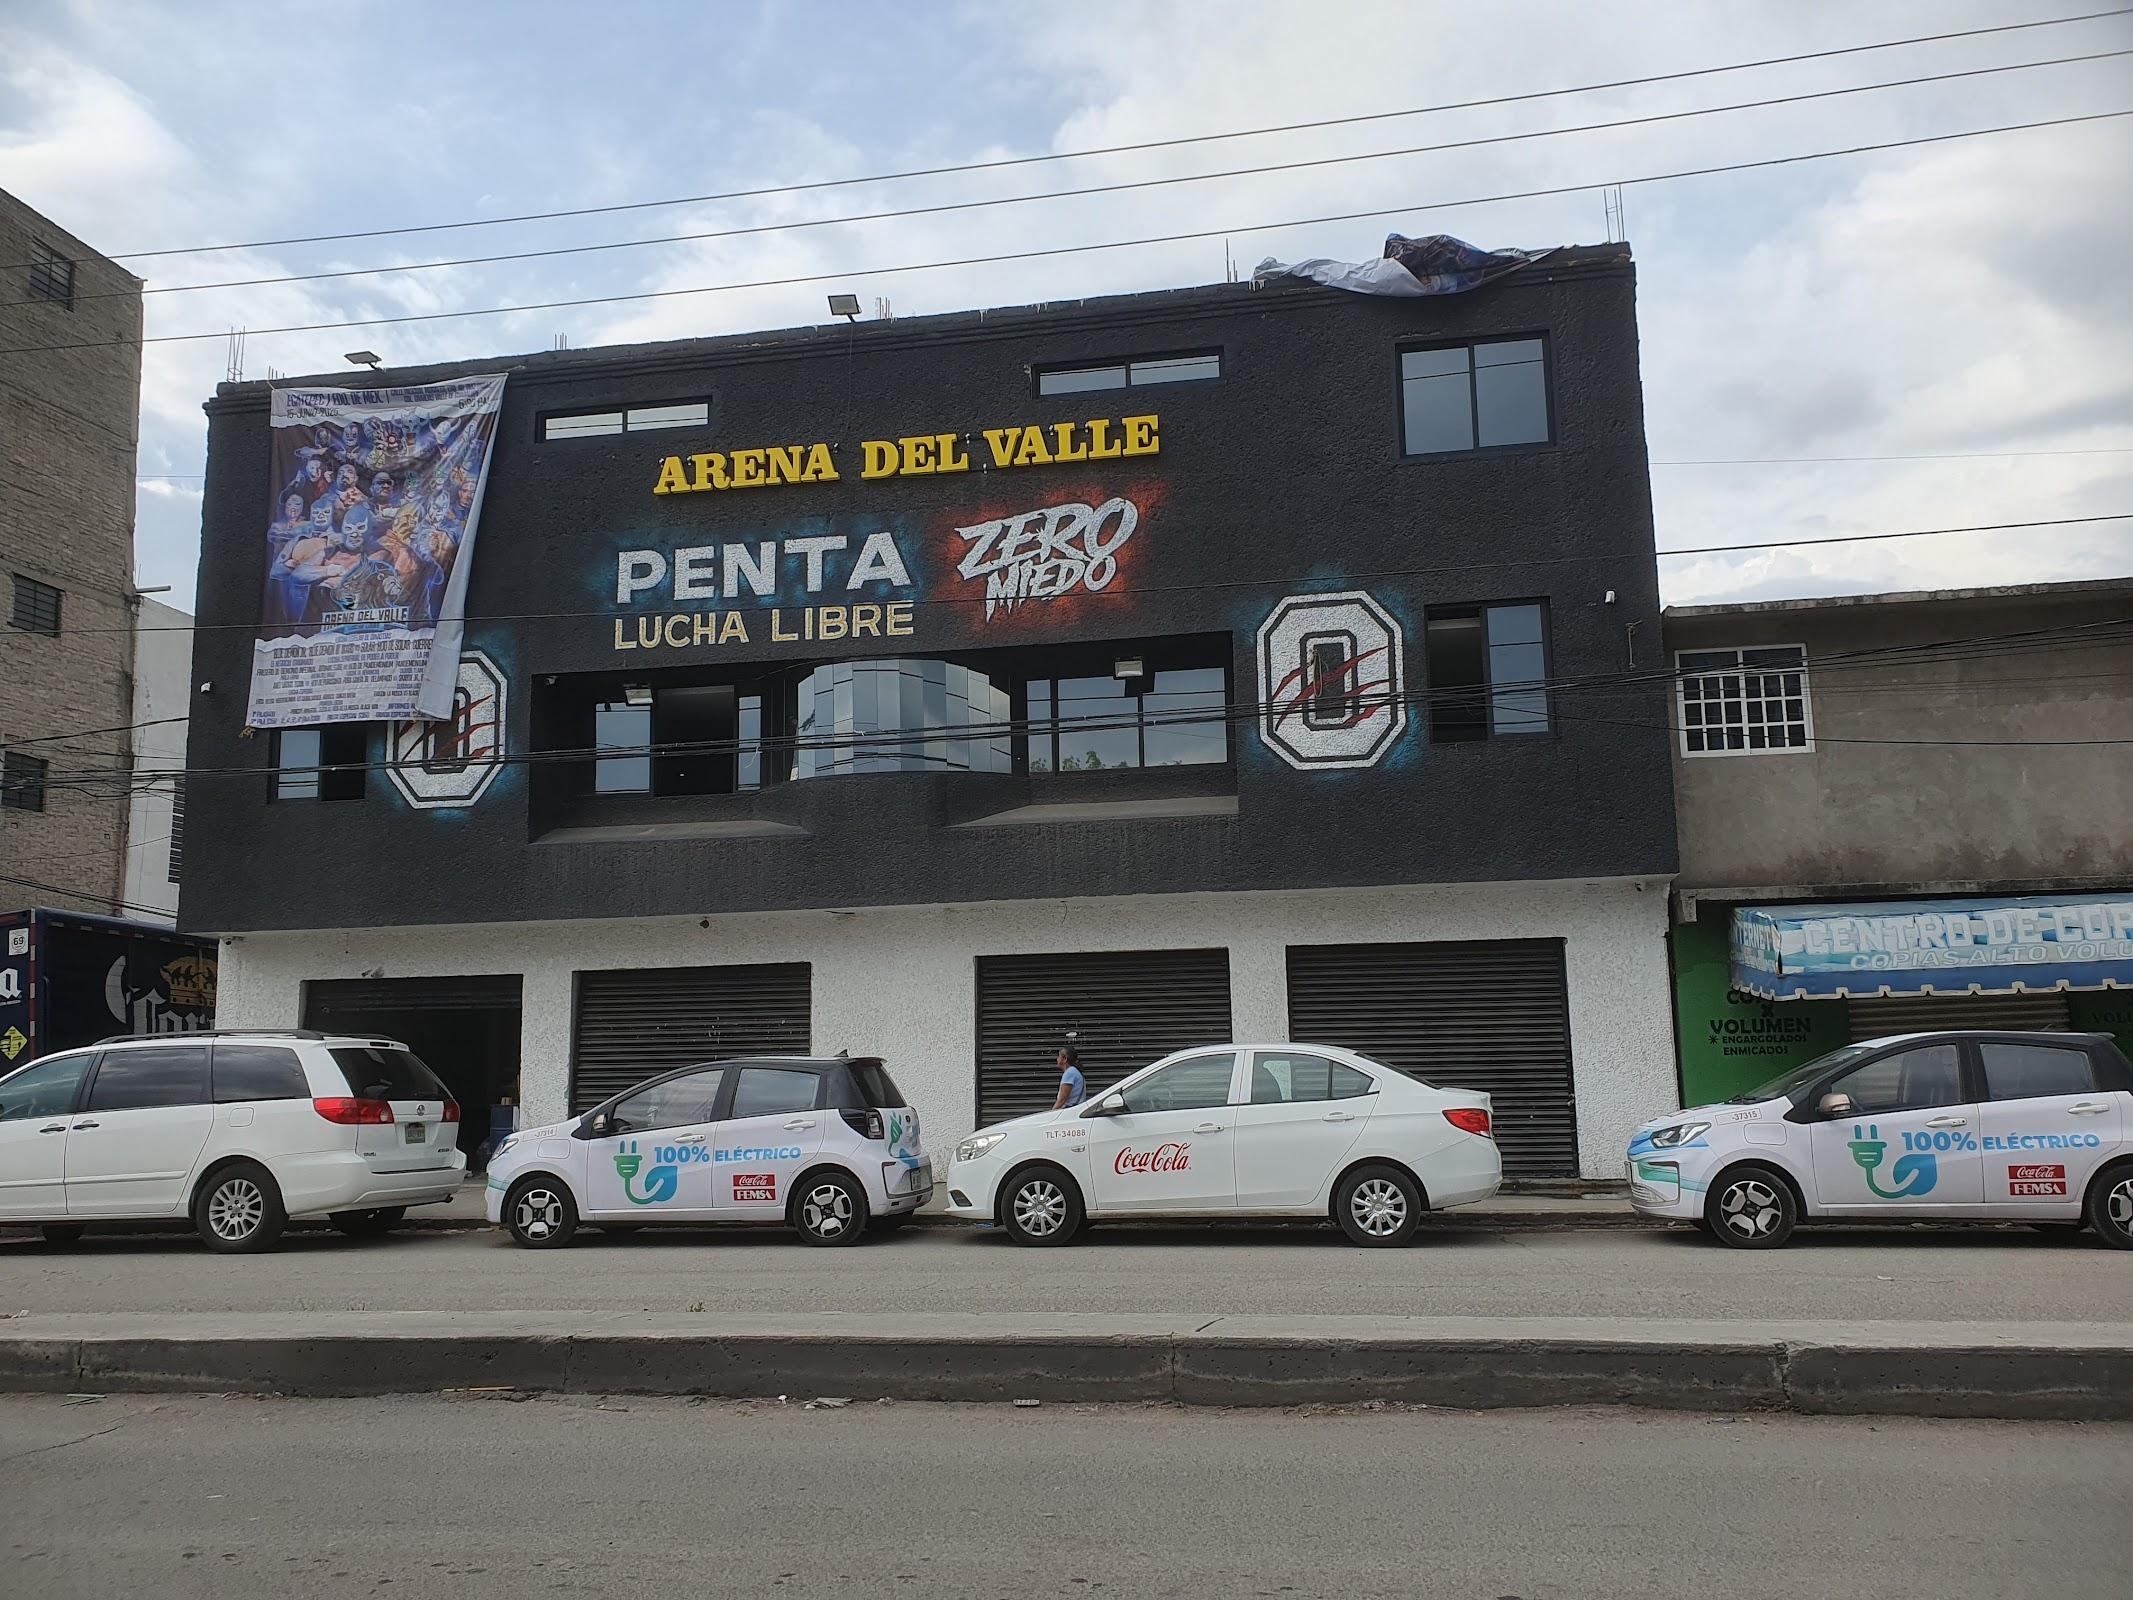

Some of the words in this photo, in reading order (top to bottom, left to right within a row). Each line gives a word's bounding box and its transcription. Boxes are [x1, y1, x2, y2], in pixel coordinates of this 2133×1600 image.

[653, 442, 840, 495] ARENA
[861, 433, 969, 480] DEL
[983, 415, 1161, 468] VALLE
[953, 497, 1138, 581] ZERO
[616, 532, 911, 604] PENTA
[985, 555, 1117, 623] MIEDO
[358, 611, 375, 622] DEL
[614, 611, 749, 650] LUCHA
[772, 600, 915, 642] LIBRE
[13, 936, 24, 946] 69
[1802, 913, 1972, 956] CENTRO
[1986, 909, 2042, 945] DE
[1850, 948, 1960, 970] COPIAS
[1967, 945, 2047, 965] ALTO
[1710, 1017, 1812, 1035] VOLUMEN
[1722, 1033, 1807, 1044] ENGARGOLADOS
[1723, 1045, 1788, 1056] ENMICADOS
[1045, 1128, 1086, 1139] TLT-34088
[1901, 1131, 1978, 1152] 100%
[1982, 1131, 2100, 1151] ELÉCTRICO
[653, 1145, 710, 1163] 100%
[714, 1145, 802, 1162] ELÉCTRICO
[736, 1189, 773, 1200] FEMSA
[2014, 1183, 2063, 1196] FEMSA
